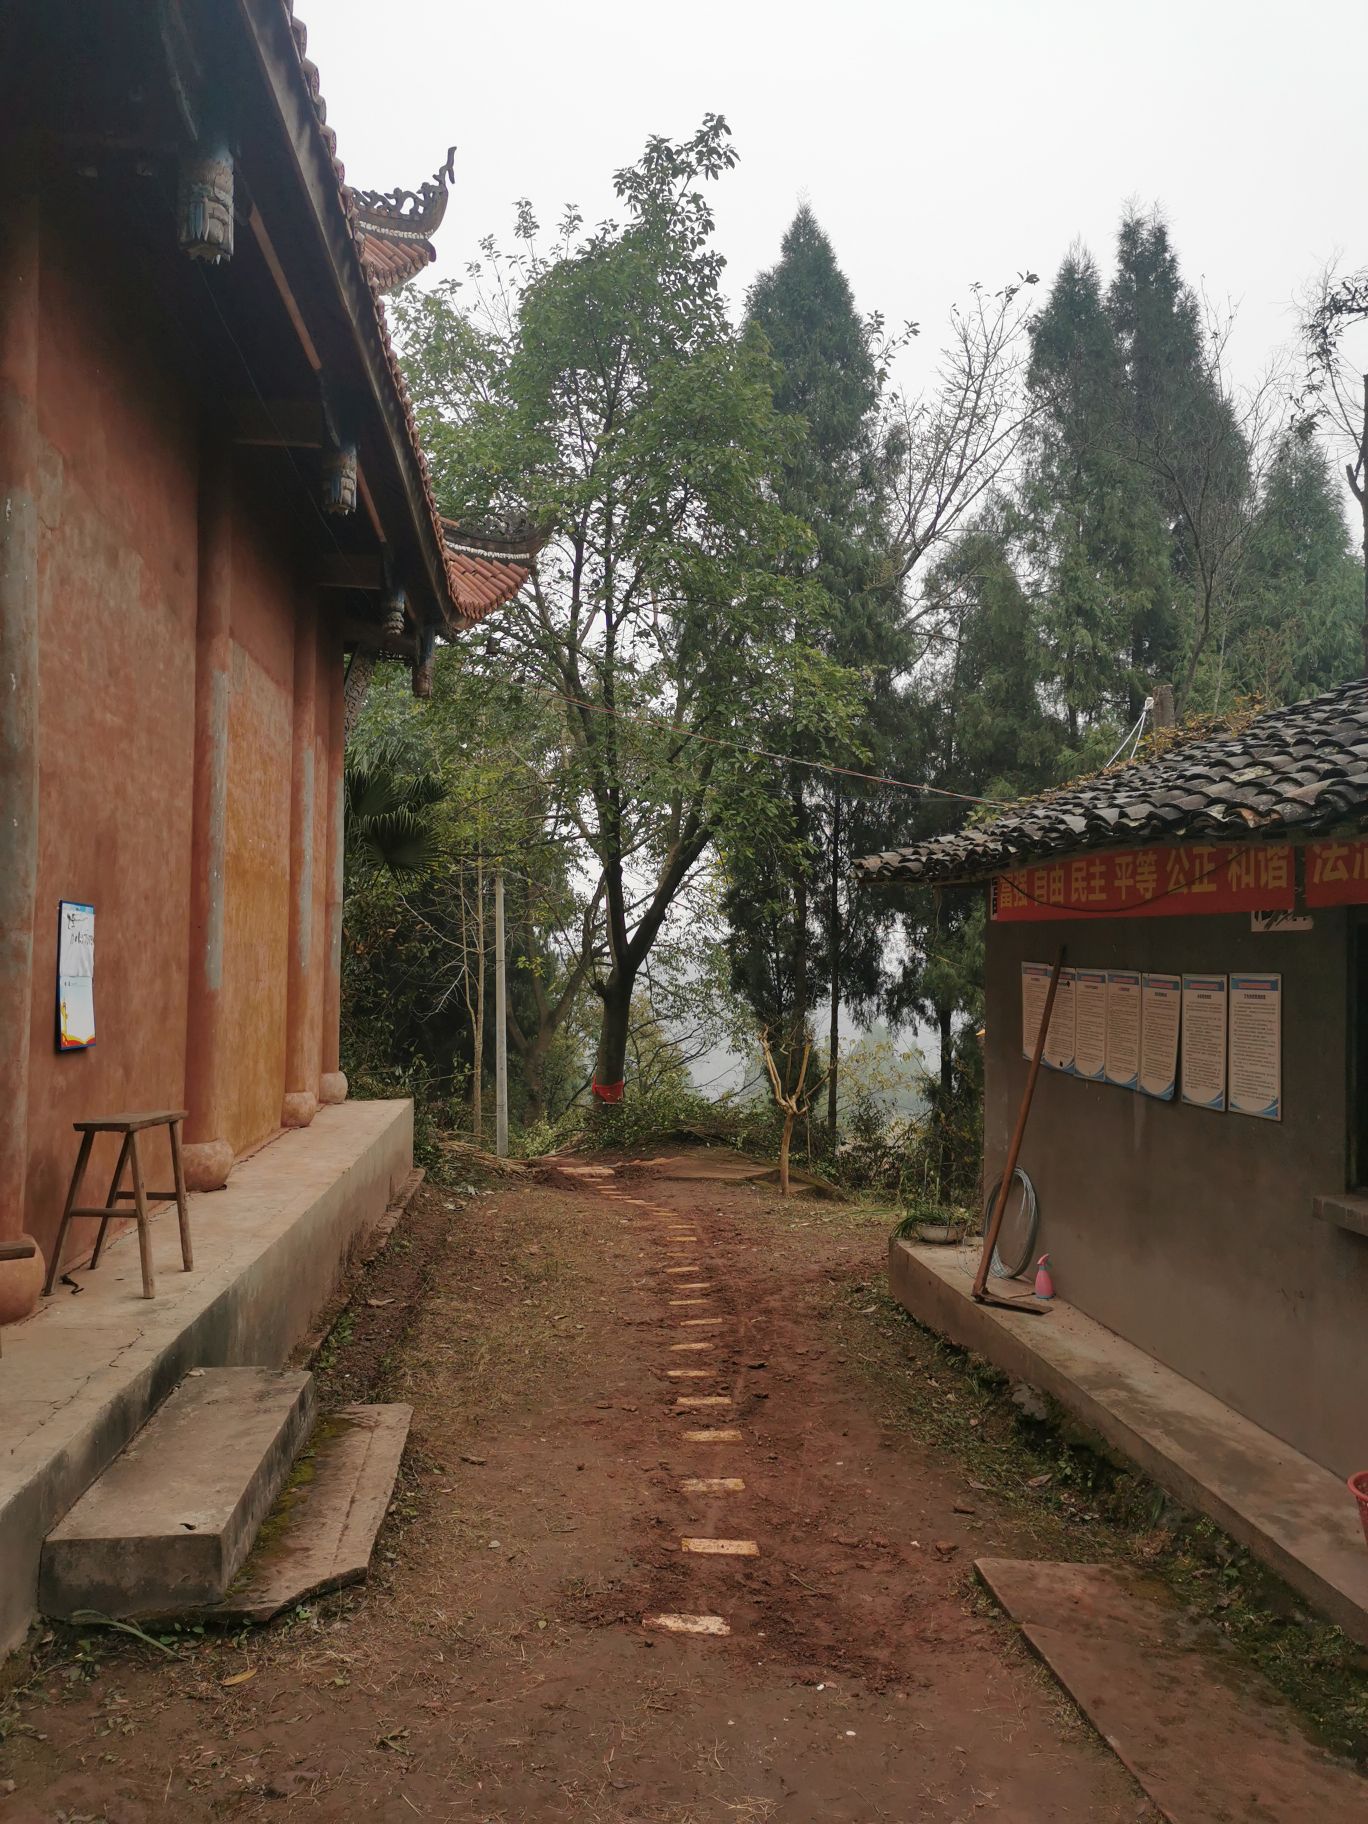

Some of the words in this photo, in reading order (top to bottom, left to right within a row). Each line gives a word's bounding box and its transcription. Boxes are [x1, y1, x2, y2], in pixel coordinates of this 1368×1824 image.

[1034, 866, 1065, 906] 自由
[1071, 859, 1107, 903] 民主
[1114, 853, 1158, 901] 平等
[1166, 848, 1217, 894] 公正
[1228, 846, 1289, 892] 和谐
